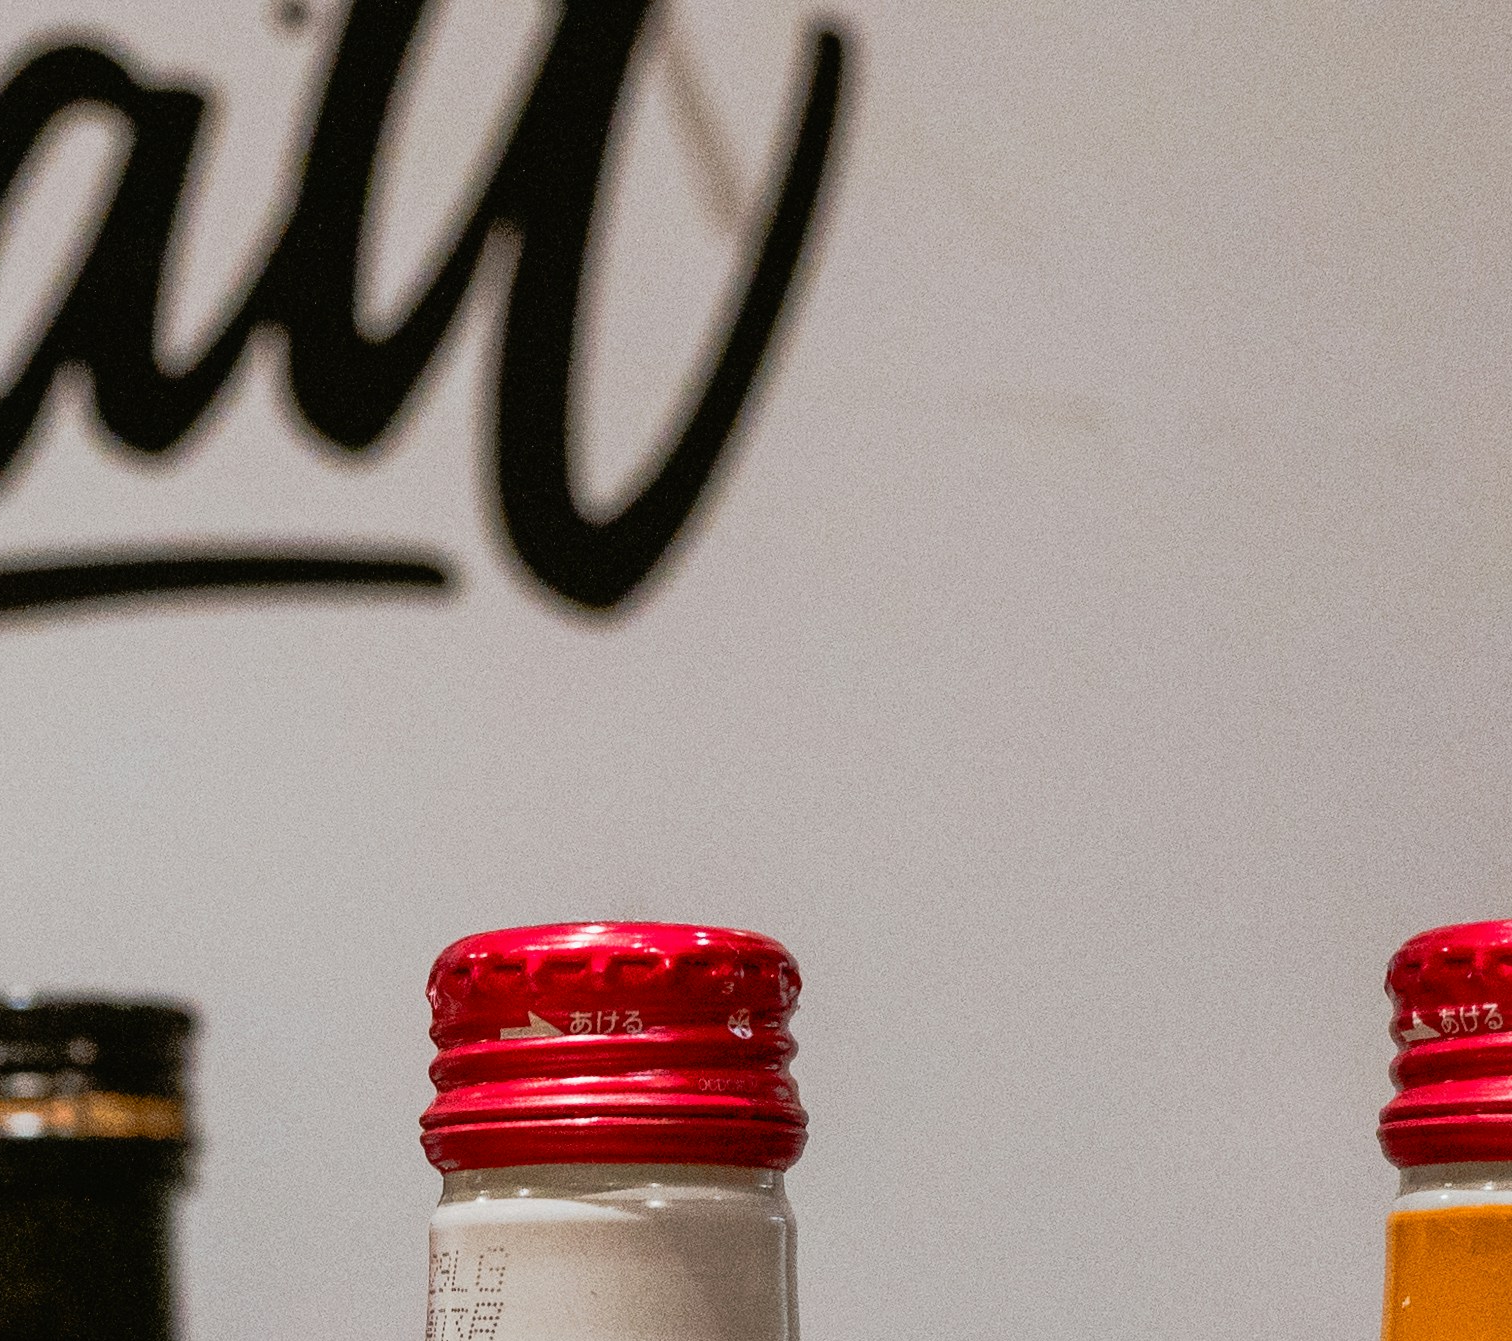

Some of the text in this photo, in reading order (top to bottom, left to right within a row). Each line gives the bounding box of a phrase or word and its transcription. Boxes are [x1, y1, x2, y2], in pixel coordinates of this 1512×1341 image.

[568, 1010, 644, 1035] あける
[1439, 1001, 1504, 1036] あける
